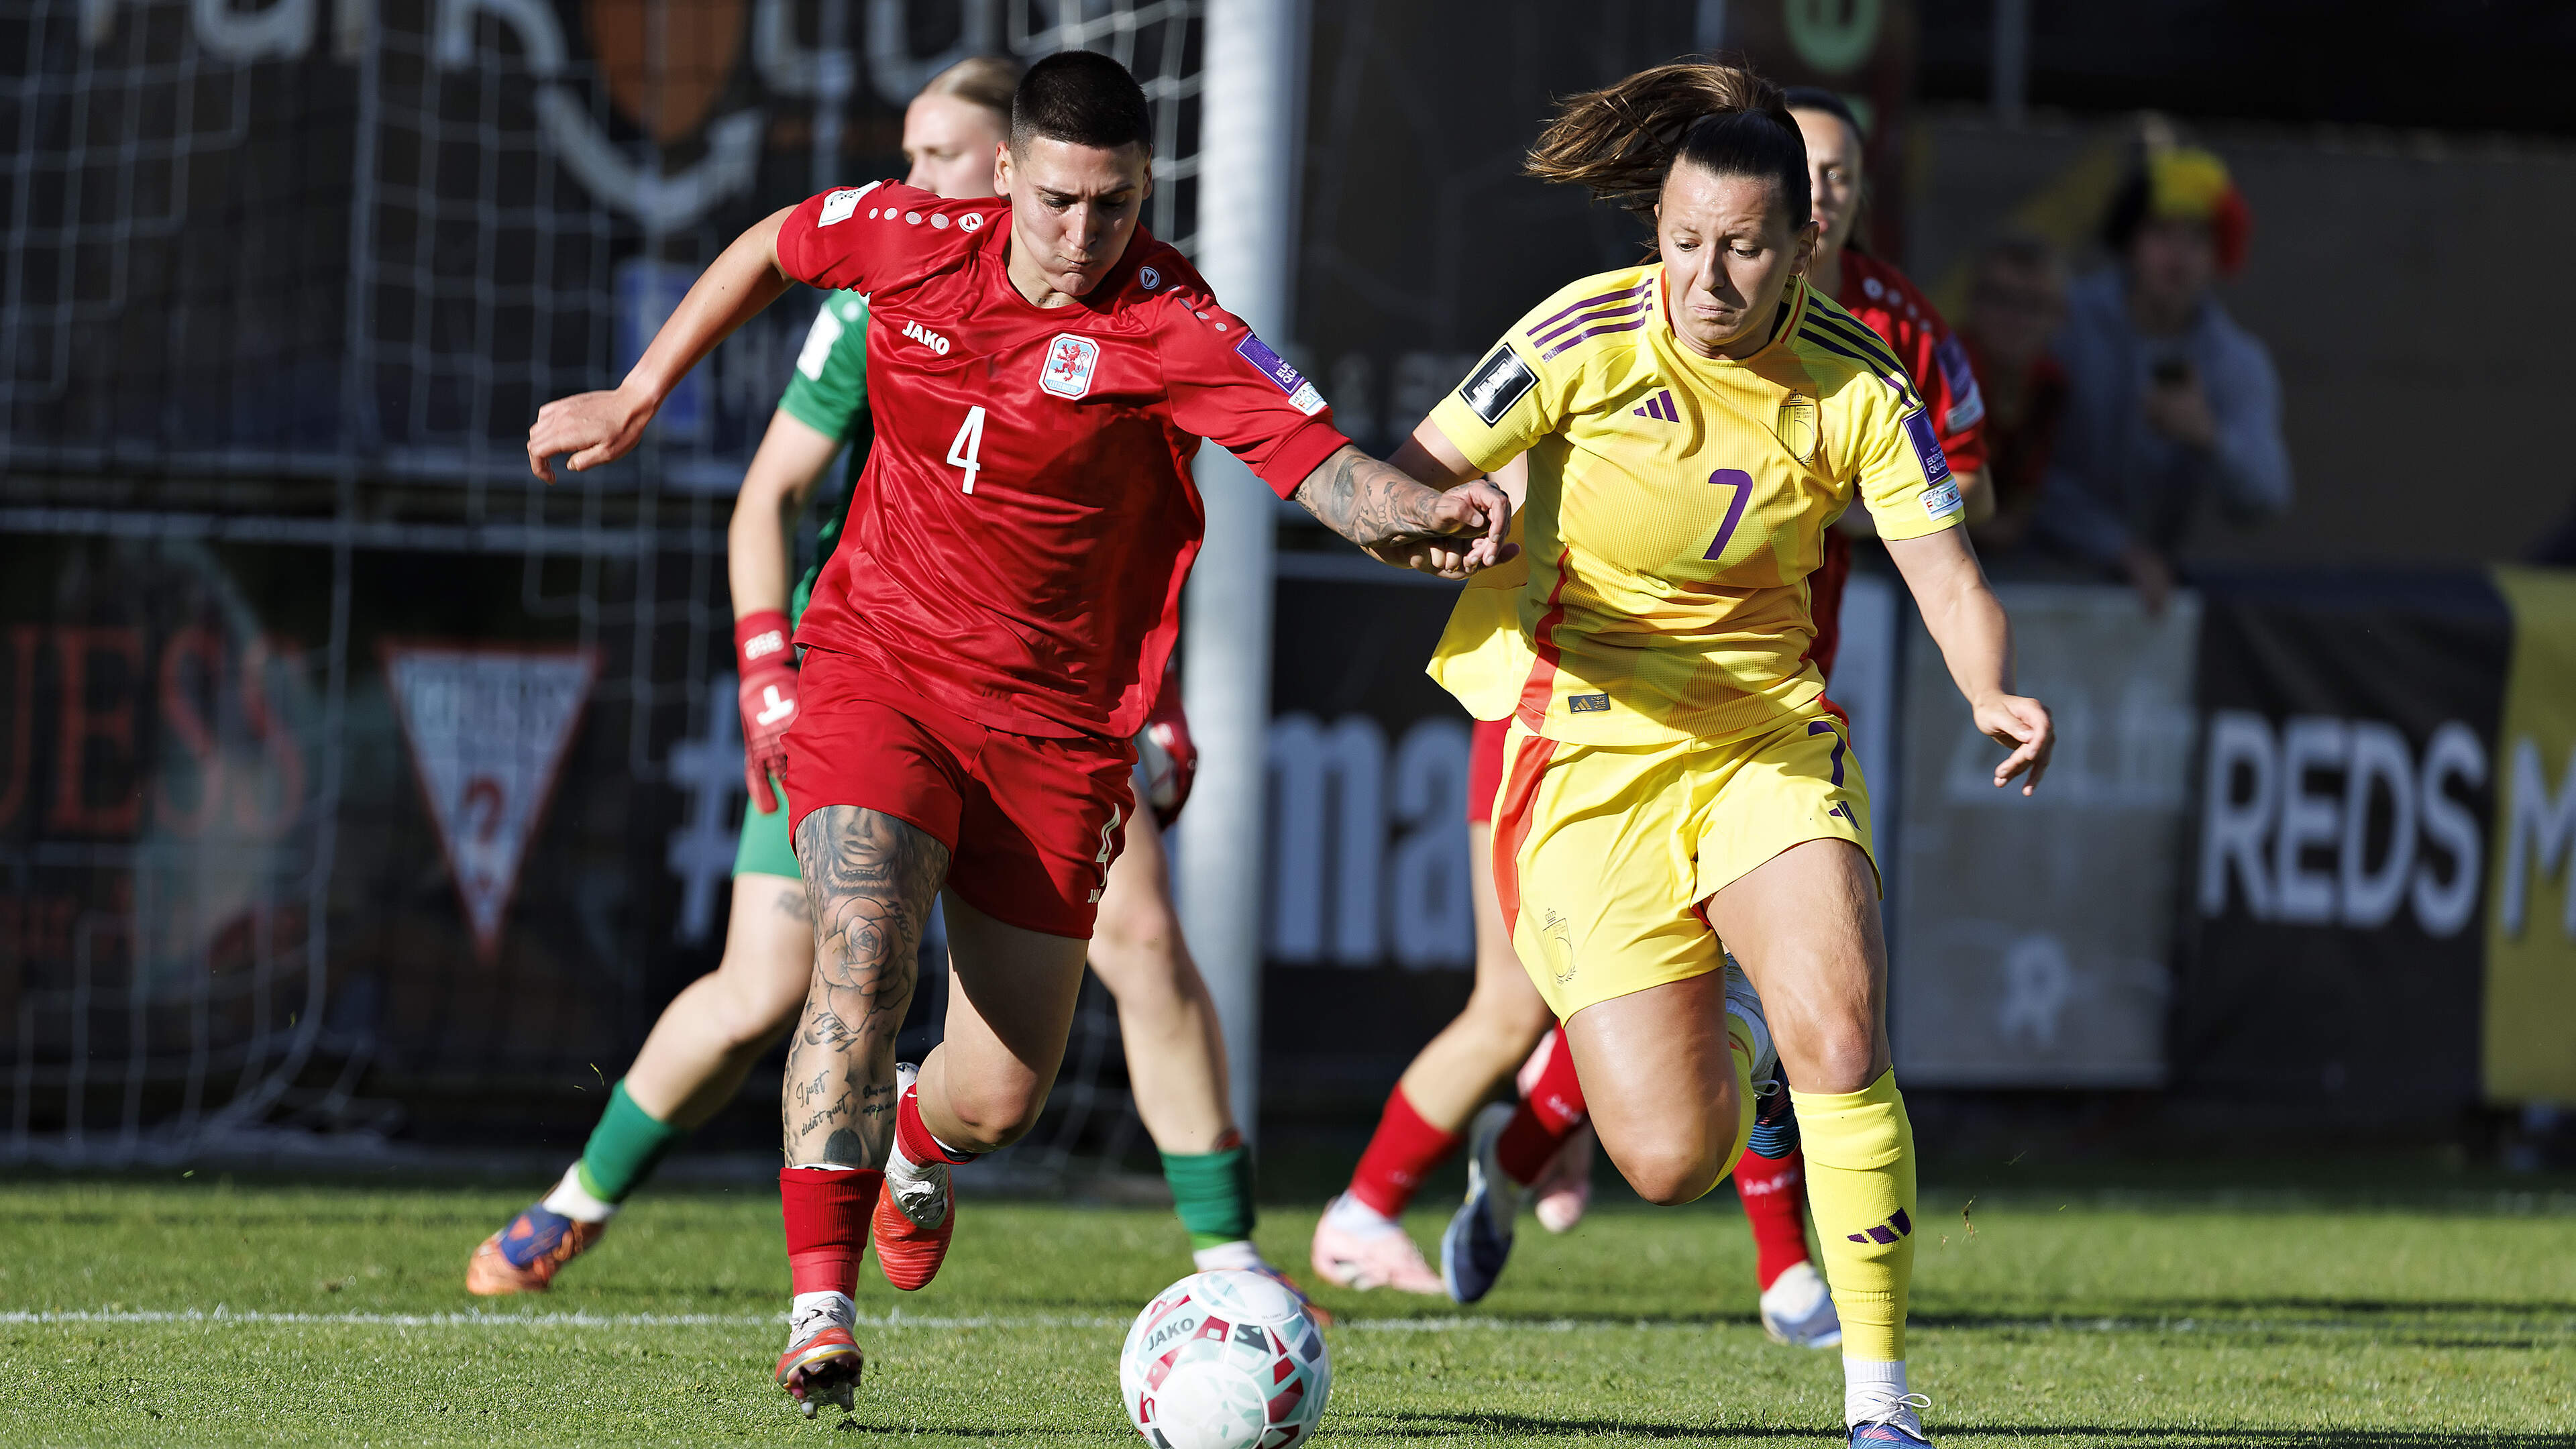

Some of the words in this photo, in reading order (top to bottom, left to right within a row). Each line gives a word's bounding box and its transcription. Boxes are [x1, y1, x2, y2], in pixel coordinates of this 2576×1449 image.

[902, 320, 950, 356] JAKO
[947, 405, 986, 495] 4
[1703, 468, 1754, 561] 7
[1808, 720, 1846, 789] 7
[1095, 802, 1121, 888] 4
[2200, 711, 2485, 937] REDS
[1148, 1318, 1195, 1351] JAKO
